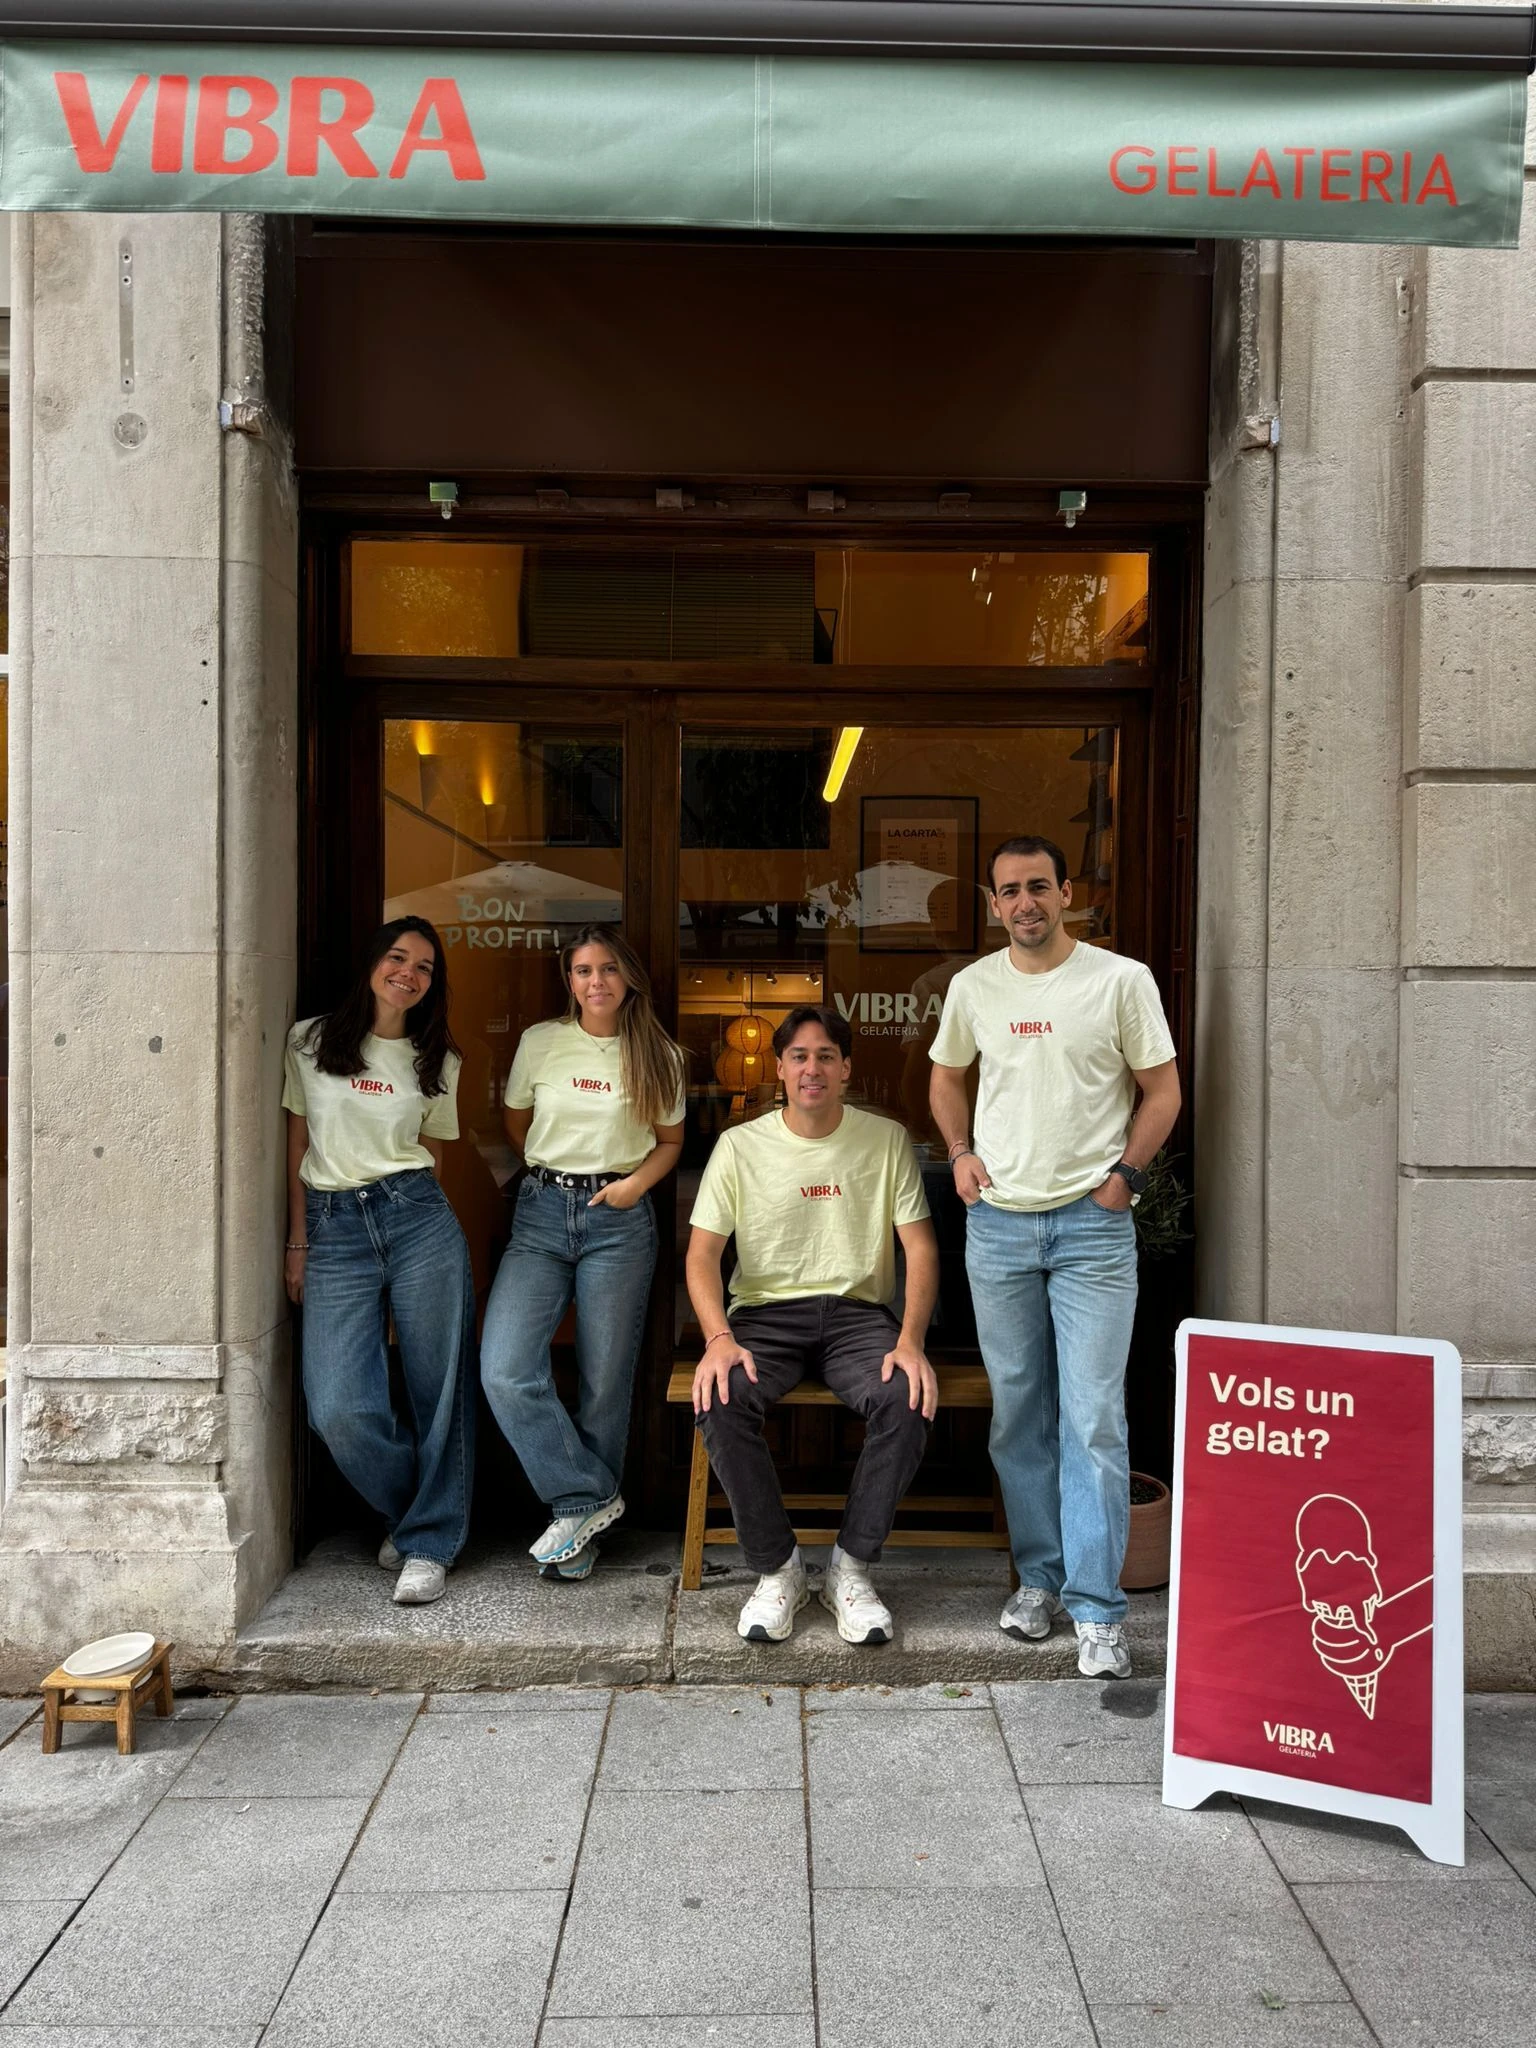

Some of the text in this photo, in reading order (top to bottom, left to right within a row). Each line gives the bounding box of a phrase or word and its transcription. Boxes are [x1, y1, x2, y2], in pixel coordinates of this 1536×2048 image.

[54, 72, 487, 181] VIBRA
[1109, 145, 1458, 207] GELATERIA
[887, 829, 901, 838] LA
[903, 829, 938, 838] CARTA
[457, 895, 526, 922] BON
[445, 925, 561, 954] PROFIT!
[833, 992, 944, 1023] VIBRA
[860, 1026, 920, 1036] GELATERIA
[1009, 1021, 1052, 1034] VIBRA
[351, 1078, 394, 1094] VIBRA
[572, 1077, 612, 1092] VIBRA
[800, 1184, 842, 1197] VIBRA
[1209, 1372, 1355, 1417] Vols un
[1206, 1420, 1330, 1460] gelat?
[1263, 1721, 1335, 1754] VIBRA
[1279, 1745, 1316, 1758] GELATERIA
